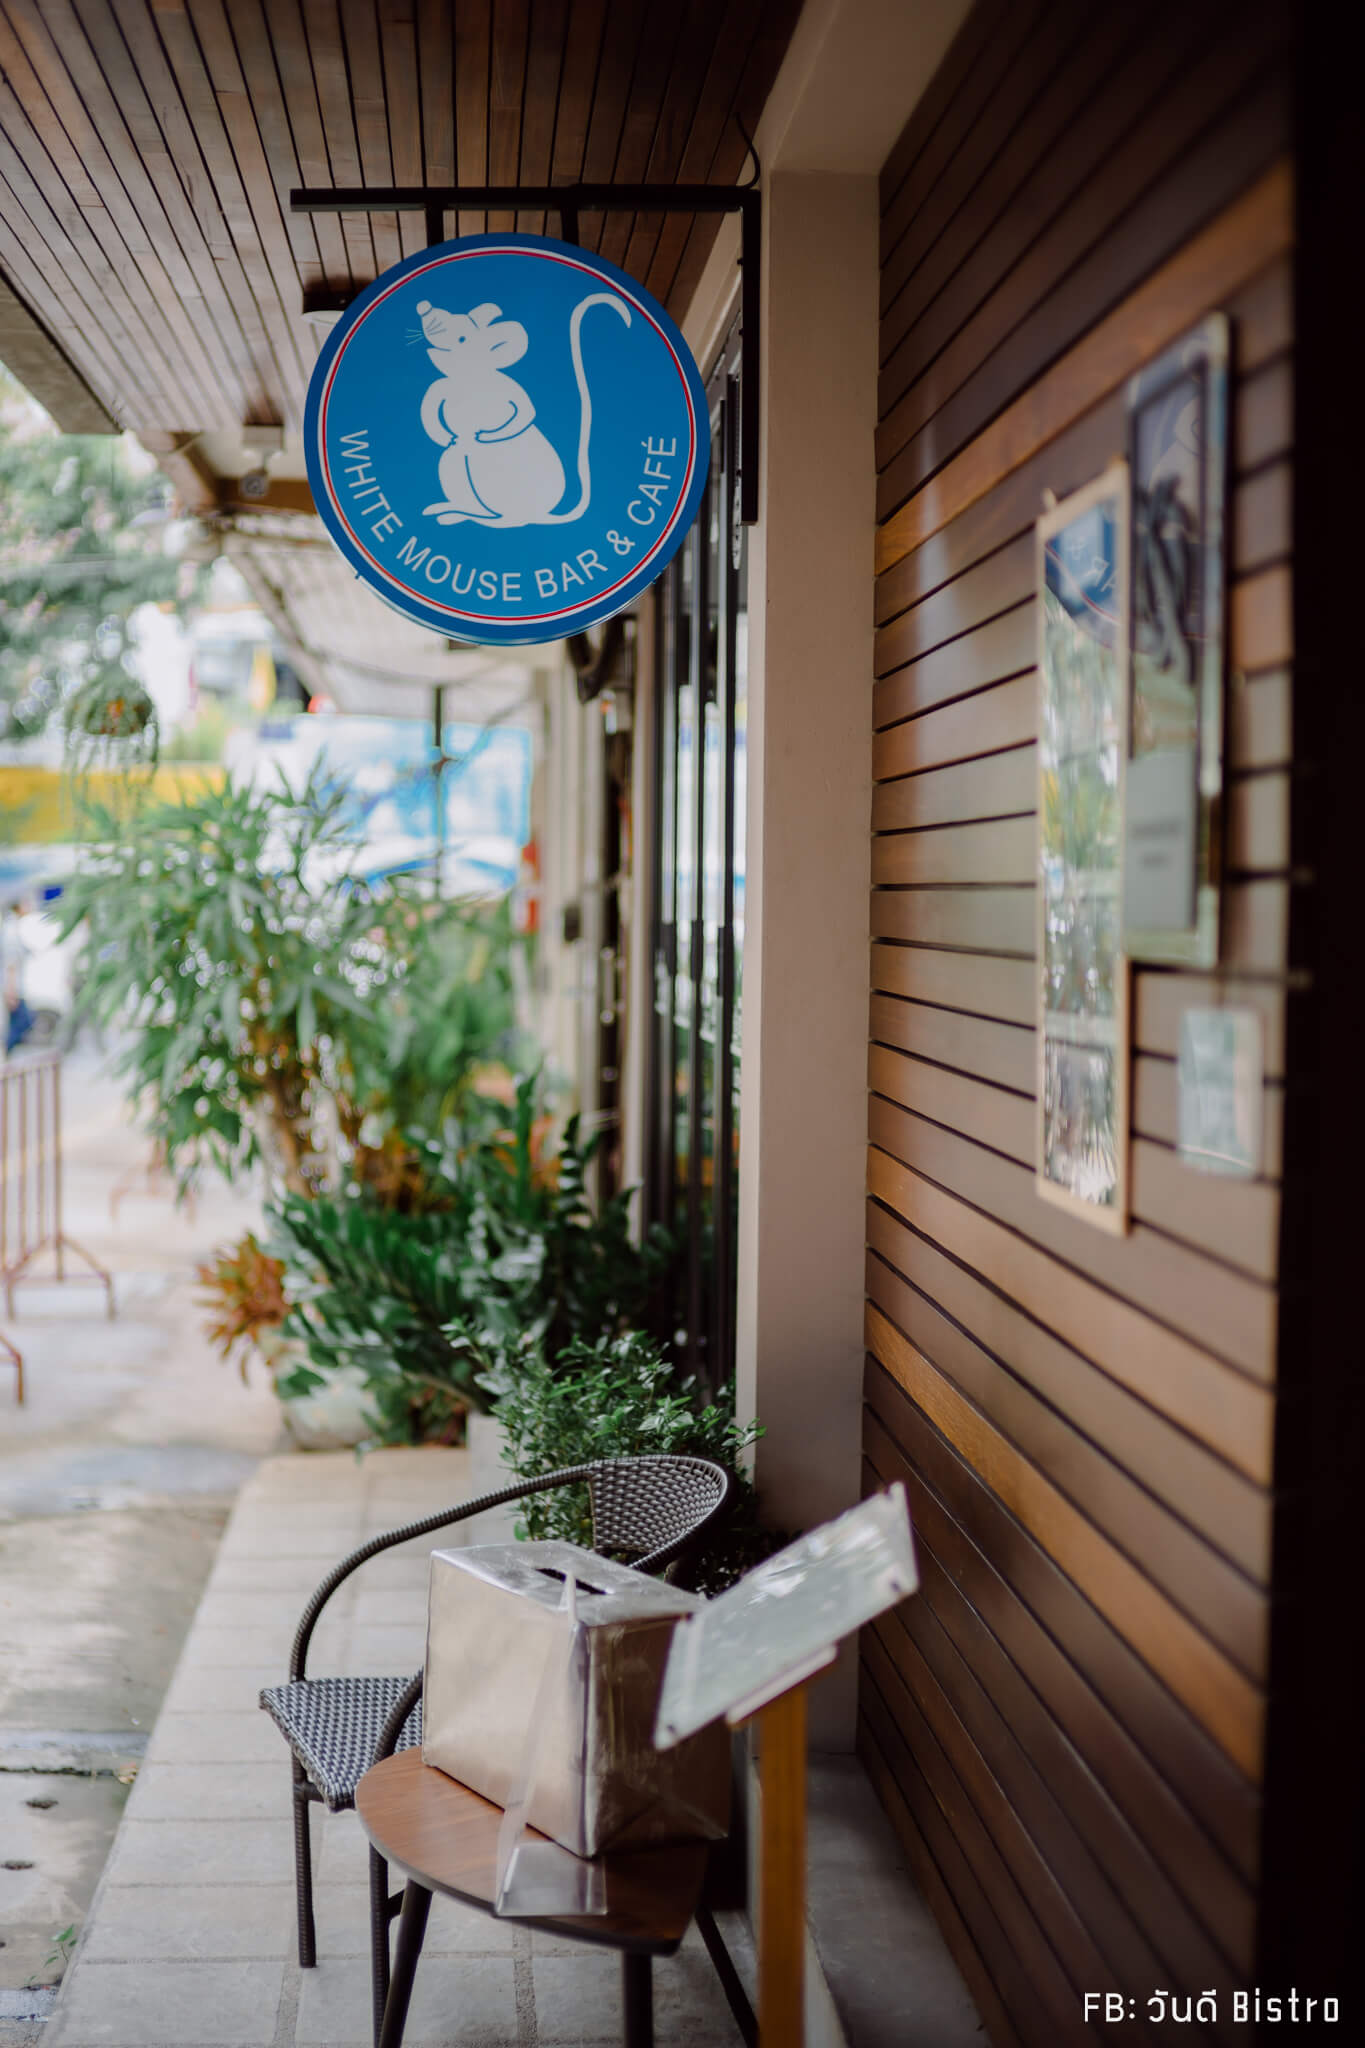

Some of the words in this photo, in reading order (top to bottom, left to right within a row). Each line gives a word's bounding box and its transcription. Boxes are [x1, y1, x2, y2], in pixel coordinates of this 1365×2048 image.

[340, 429, 403, 543] WHITE
[396, 535, 522, 602] MOUSE
[534, 548, 609, 599] BAR
[606, 529, 636, 556] &
[627, 436, 677, 526] CAFÉ
